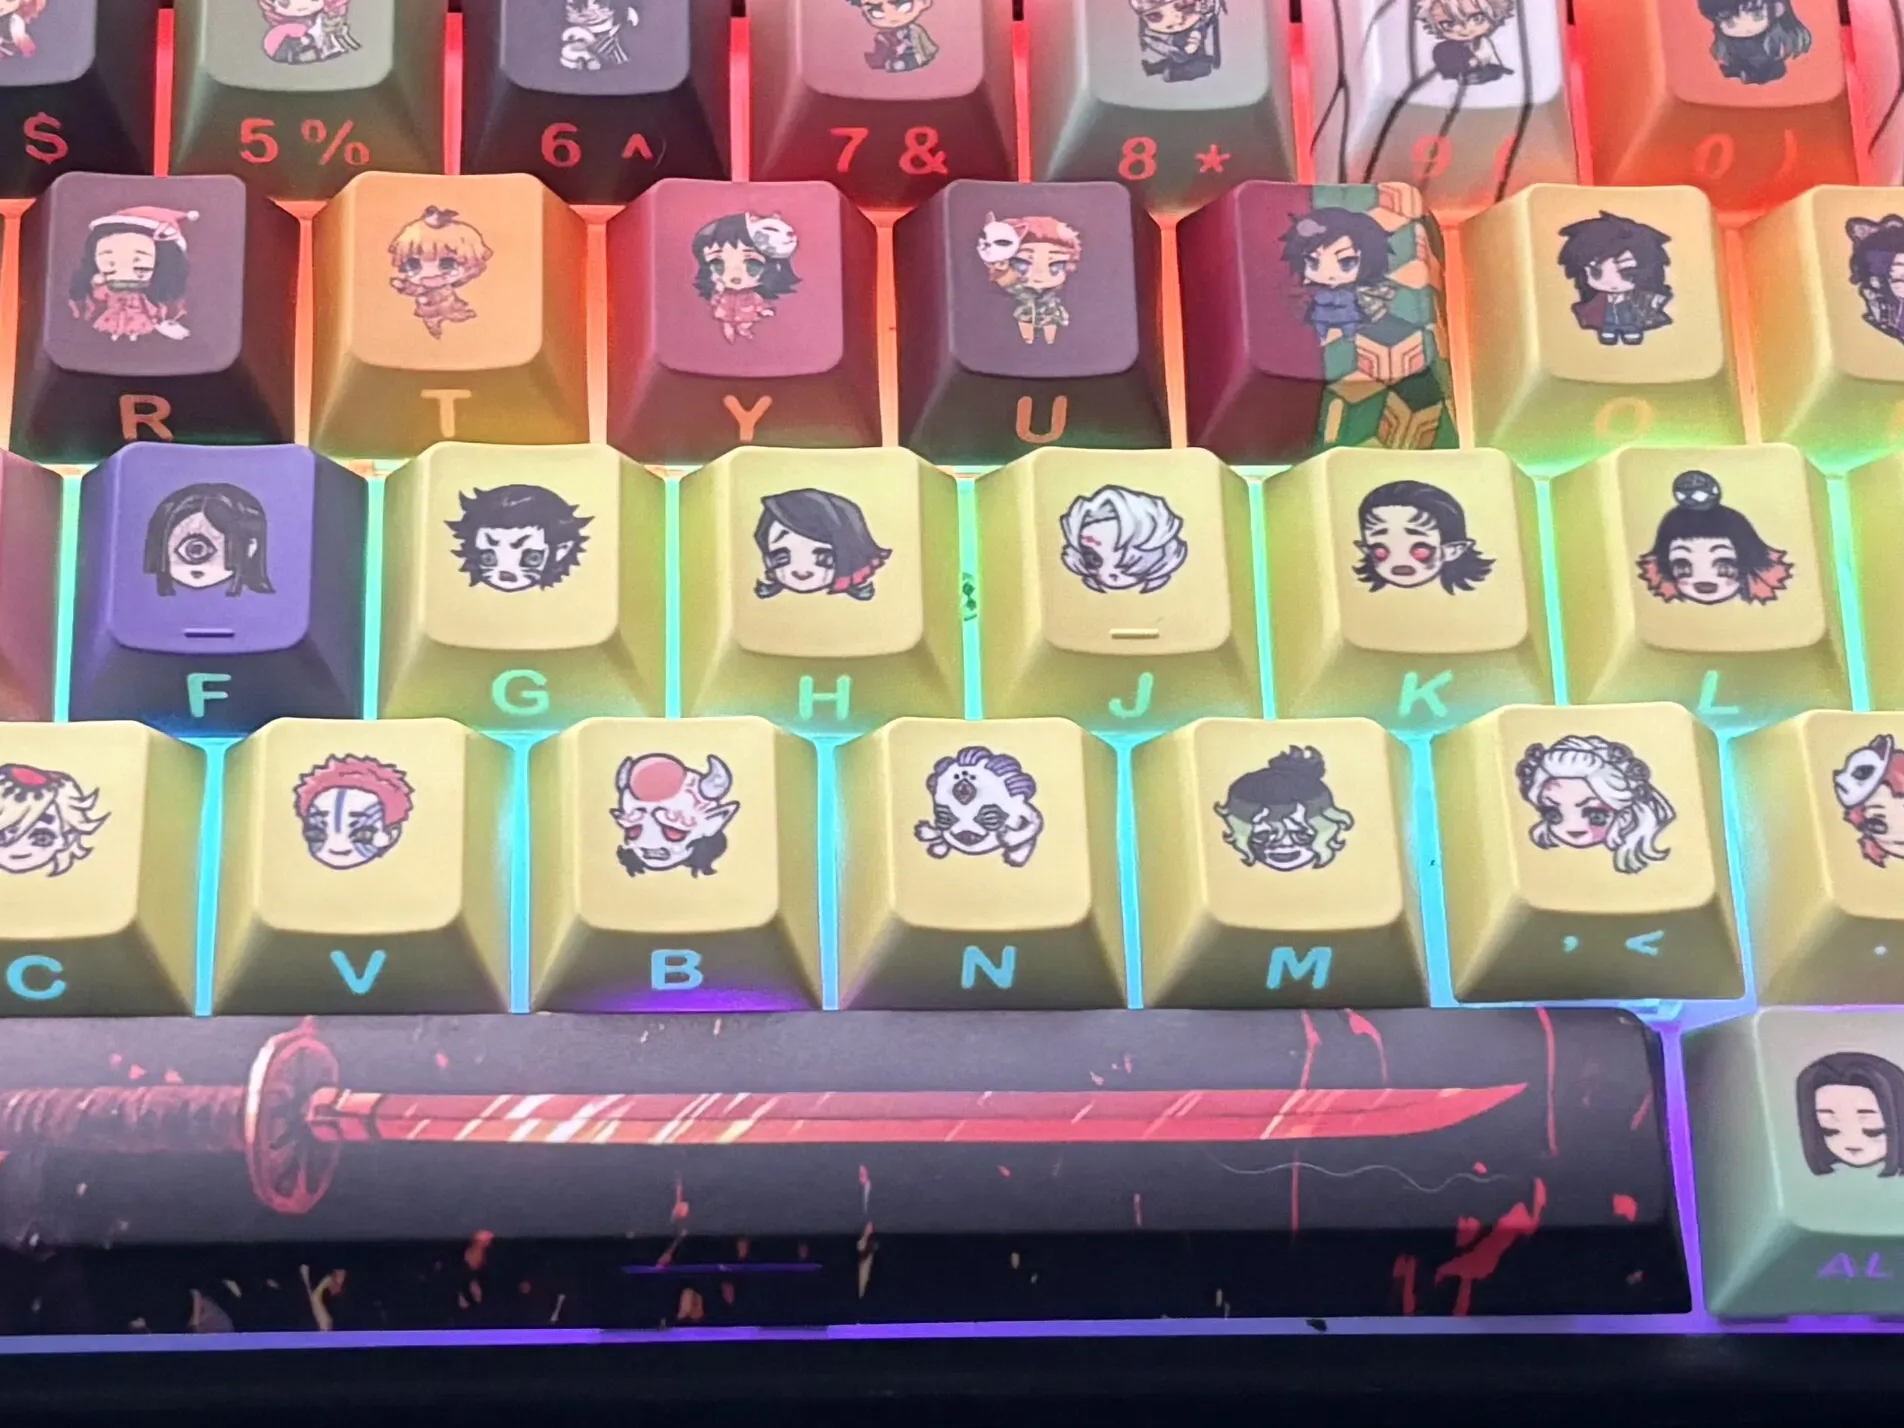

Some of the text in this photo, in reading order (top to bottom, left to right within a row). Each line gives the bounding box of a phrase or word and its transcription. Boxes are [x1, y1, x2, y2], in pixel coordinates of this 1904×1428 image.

[22, 111, 69, 164] $
[239, 118, 371, 166] 5 %
[540, 122, 582, 168] 6
[830, 126, 950, 176] 7 &
[1118, 136, 1158, 181] 8
[117, 393, 175, 442] R
[421, 388, 472, 438] T
[723, 394, 773, 442] Y
[1014, 395, 1068, 444] U
[185, 672, 233, 719] F
[491, 668, 551, 716] G
[797, 674, 852, 722] H
[1109, 672, 1155, 720] J
[1398, 670, 1454, 717] K
[1697, 670, 1741, 716] L
[5, 954, 68, 1001] C
[330, 949, 388, 996] V
[650, 948, 705, 992] B
[959, 946, 1018, 991] N
[1265, 946, 1334, 990] M
